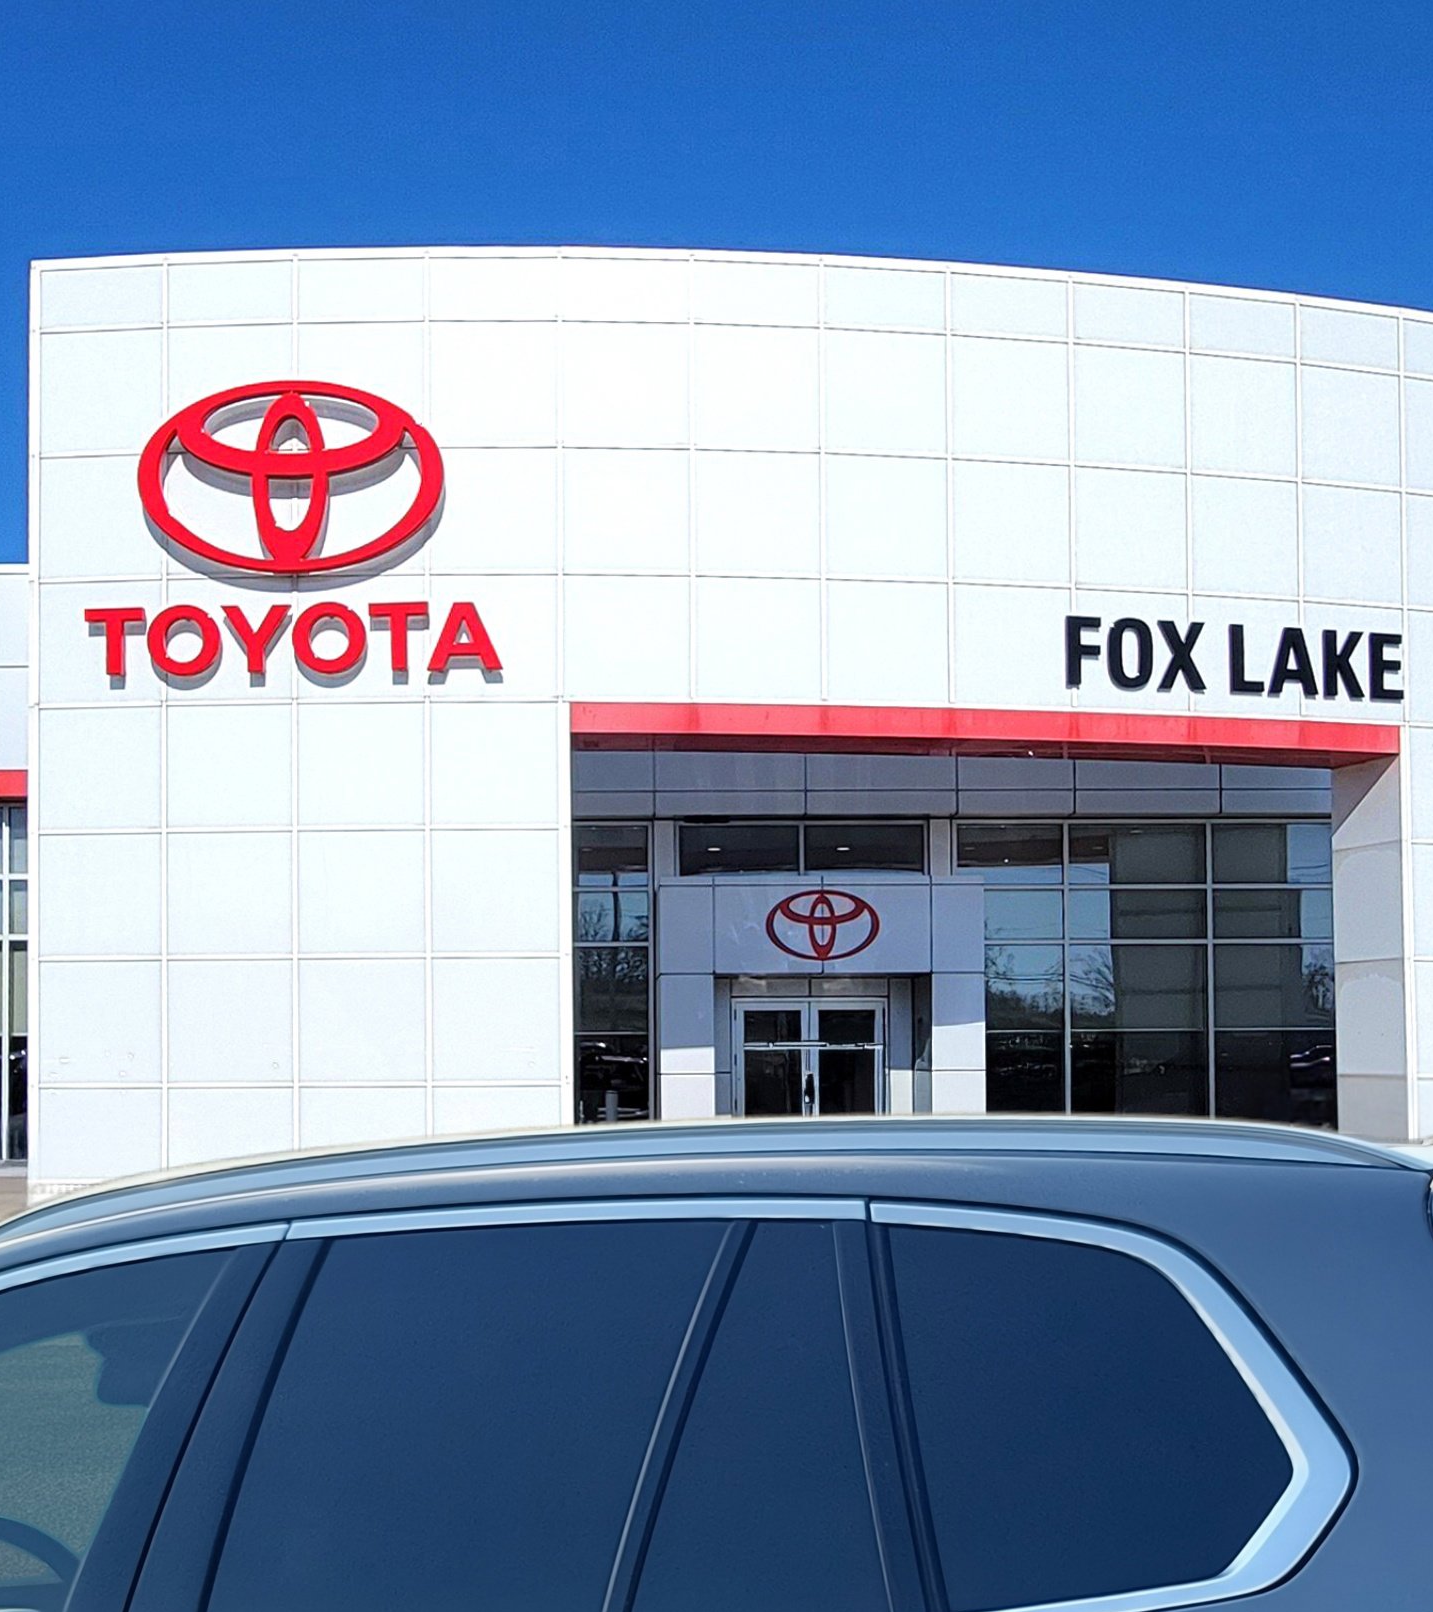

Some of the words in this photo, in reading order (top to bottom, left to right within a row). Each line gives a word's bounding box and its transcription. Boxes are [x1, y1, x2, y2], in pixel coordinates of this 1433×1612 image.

[83, 601, 502, 676] TOYOTA
[1065, 615, 1207, 693] FOX
[1228, 623, 1404, 701] LAKE
